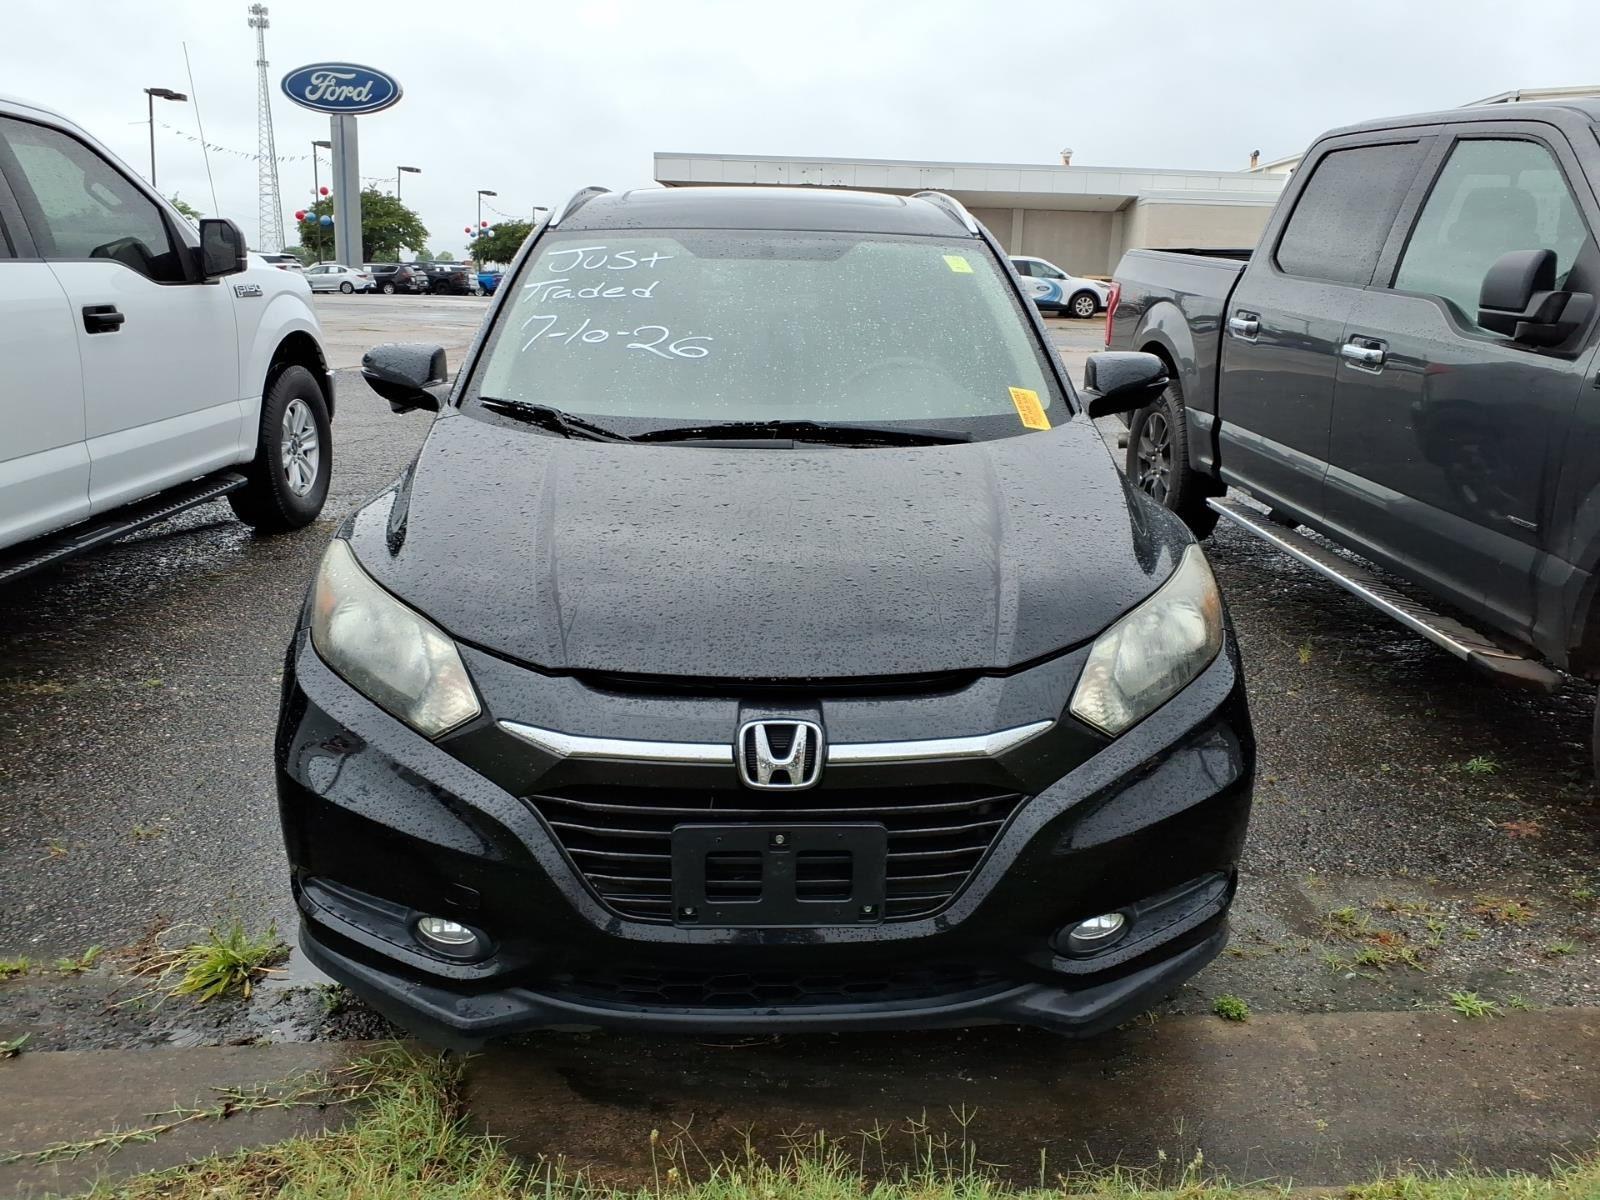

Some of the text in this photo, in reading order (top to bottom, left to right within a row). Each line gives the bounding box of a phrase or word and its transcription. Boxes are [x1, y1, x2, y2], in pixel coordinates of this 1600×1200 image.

[304, 71, 374, 102] Ford
[523, 278, 660, 303] Traded
[520, 314, 715, 360] 7-10-26
